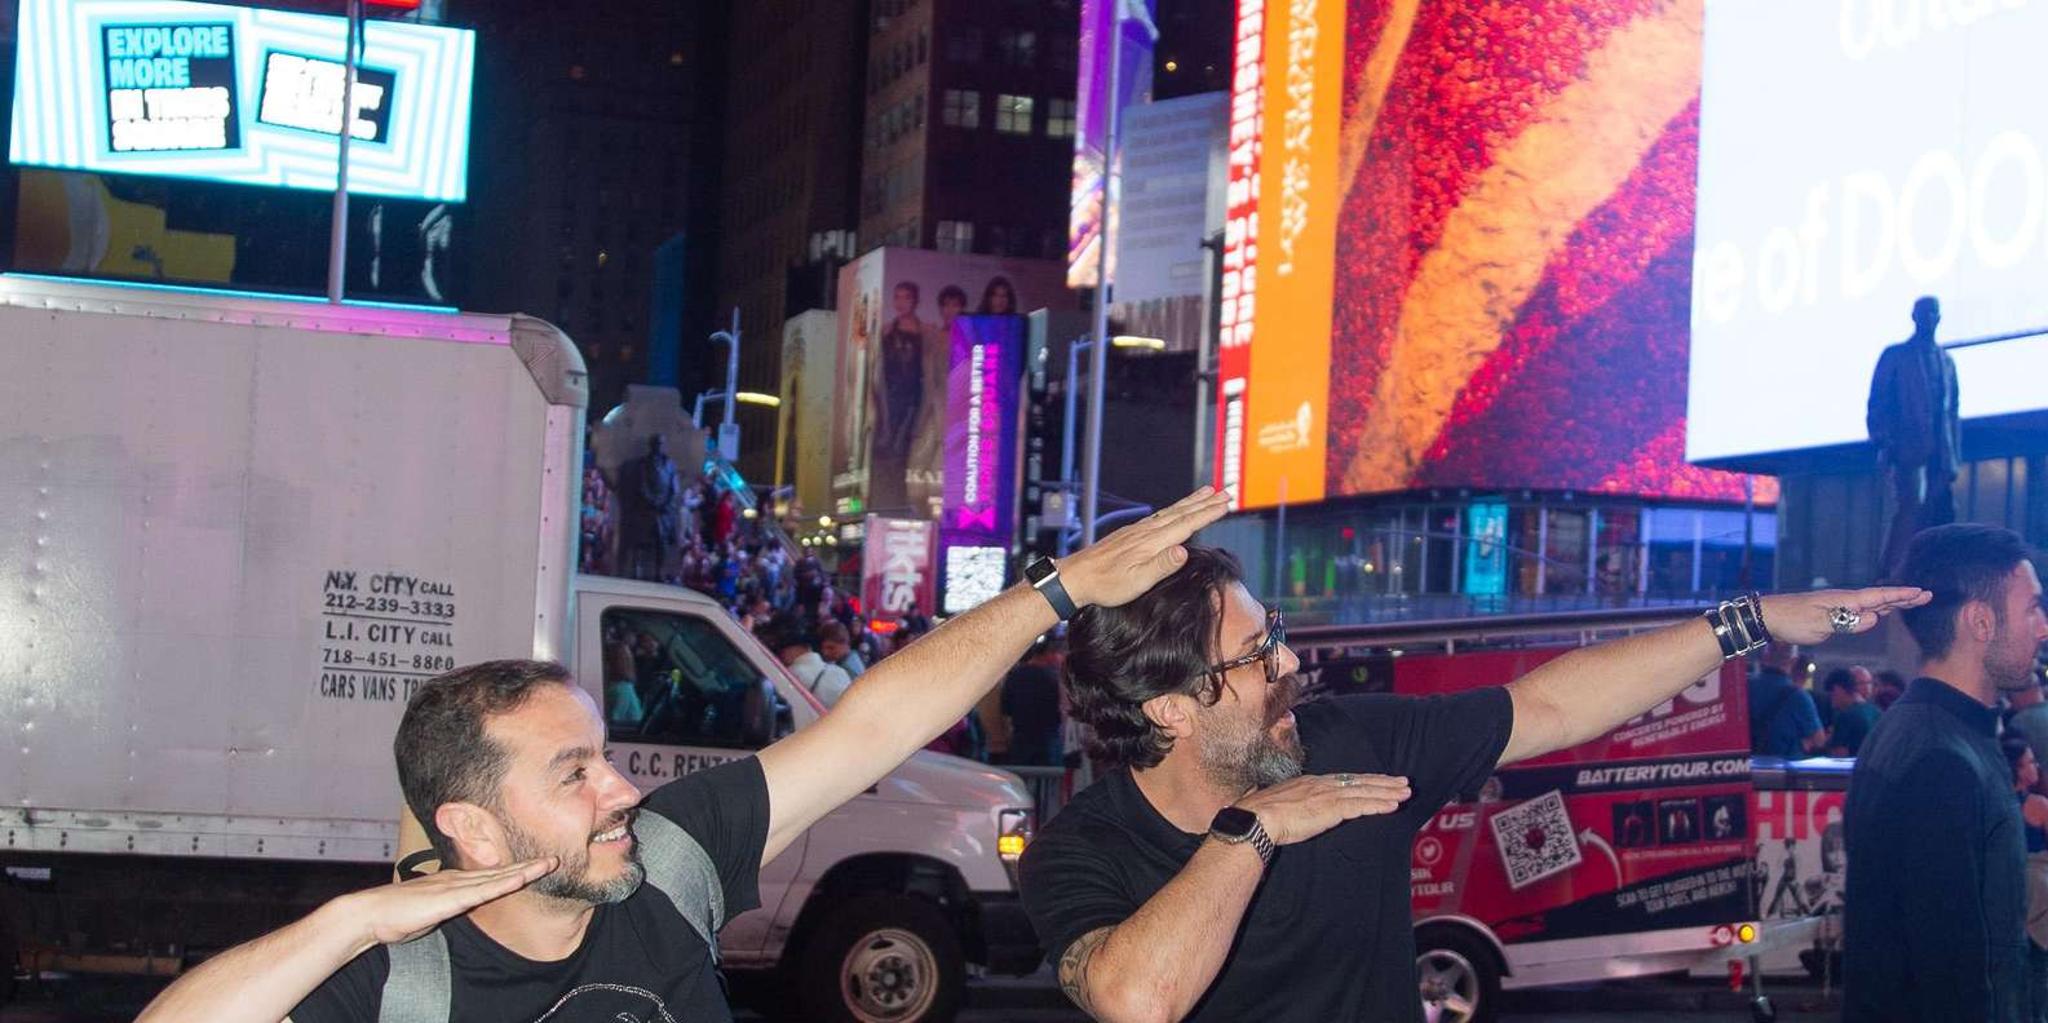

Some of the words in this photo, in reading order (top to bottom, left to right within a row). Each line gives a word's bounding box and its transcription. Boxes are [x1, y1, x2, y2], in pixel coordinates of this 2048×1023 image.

[108, 27, 228, 57] EXPLORE
[110, 58, 190, 87] MORE
[1841, 129, 2048, 302] DOO
[970, 344, 984, 393] BETTER
[971, 394, 982, 406] A
[969, 408, 982, 432] FOR
[964, 434, 981, 503] COALITION
[324, 571, 358, 592] N.Y.
[370, 574, 418, 596] CITY
[420, 582, 455, 596] CALL
[883, 530, 927, 611] tkts
[325, 593, 455, 618] 212-239-3333
[326, 621, 359, 640] L.I.
[368, 624, 416, 644] CITY
[420, 631, 453, 647] CALL
[320, 673, 356, 699] CARS
[362, 675, 396, 701] VANS
[629, 751, 668, 777] C.C.
[673, 753, 740, 777] RENT
[1576, 758, 1751, 785] BATTERYTOUR.COM
[1438, 812, 1477, 829] US
